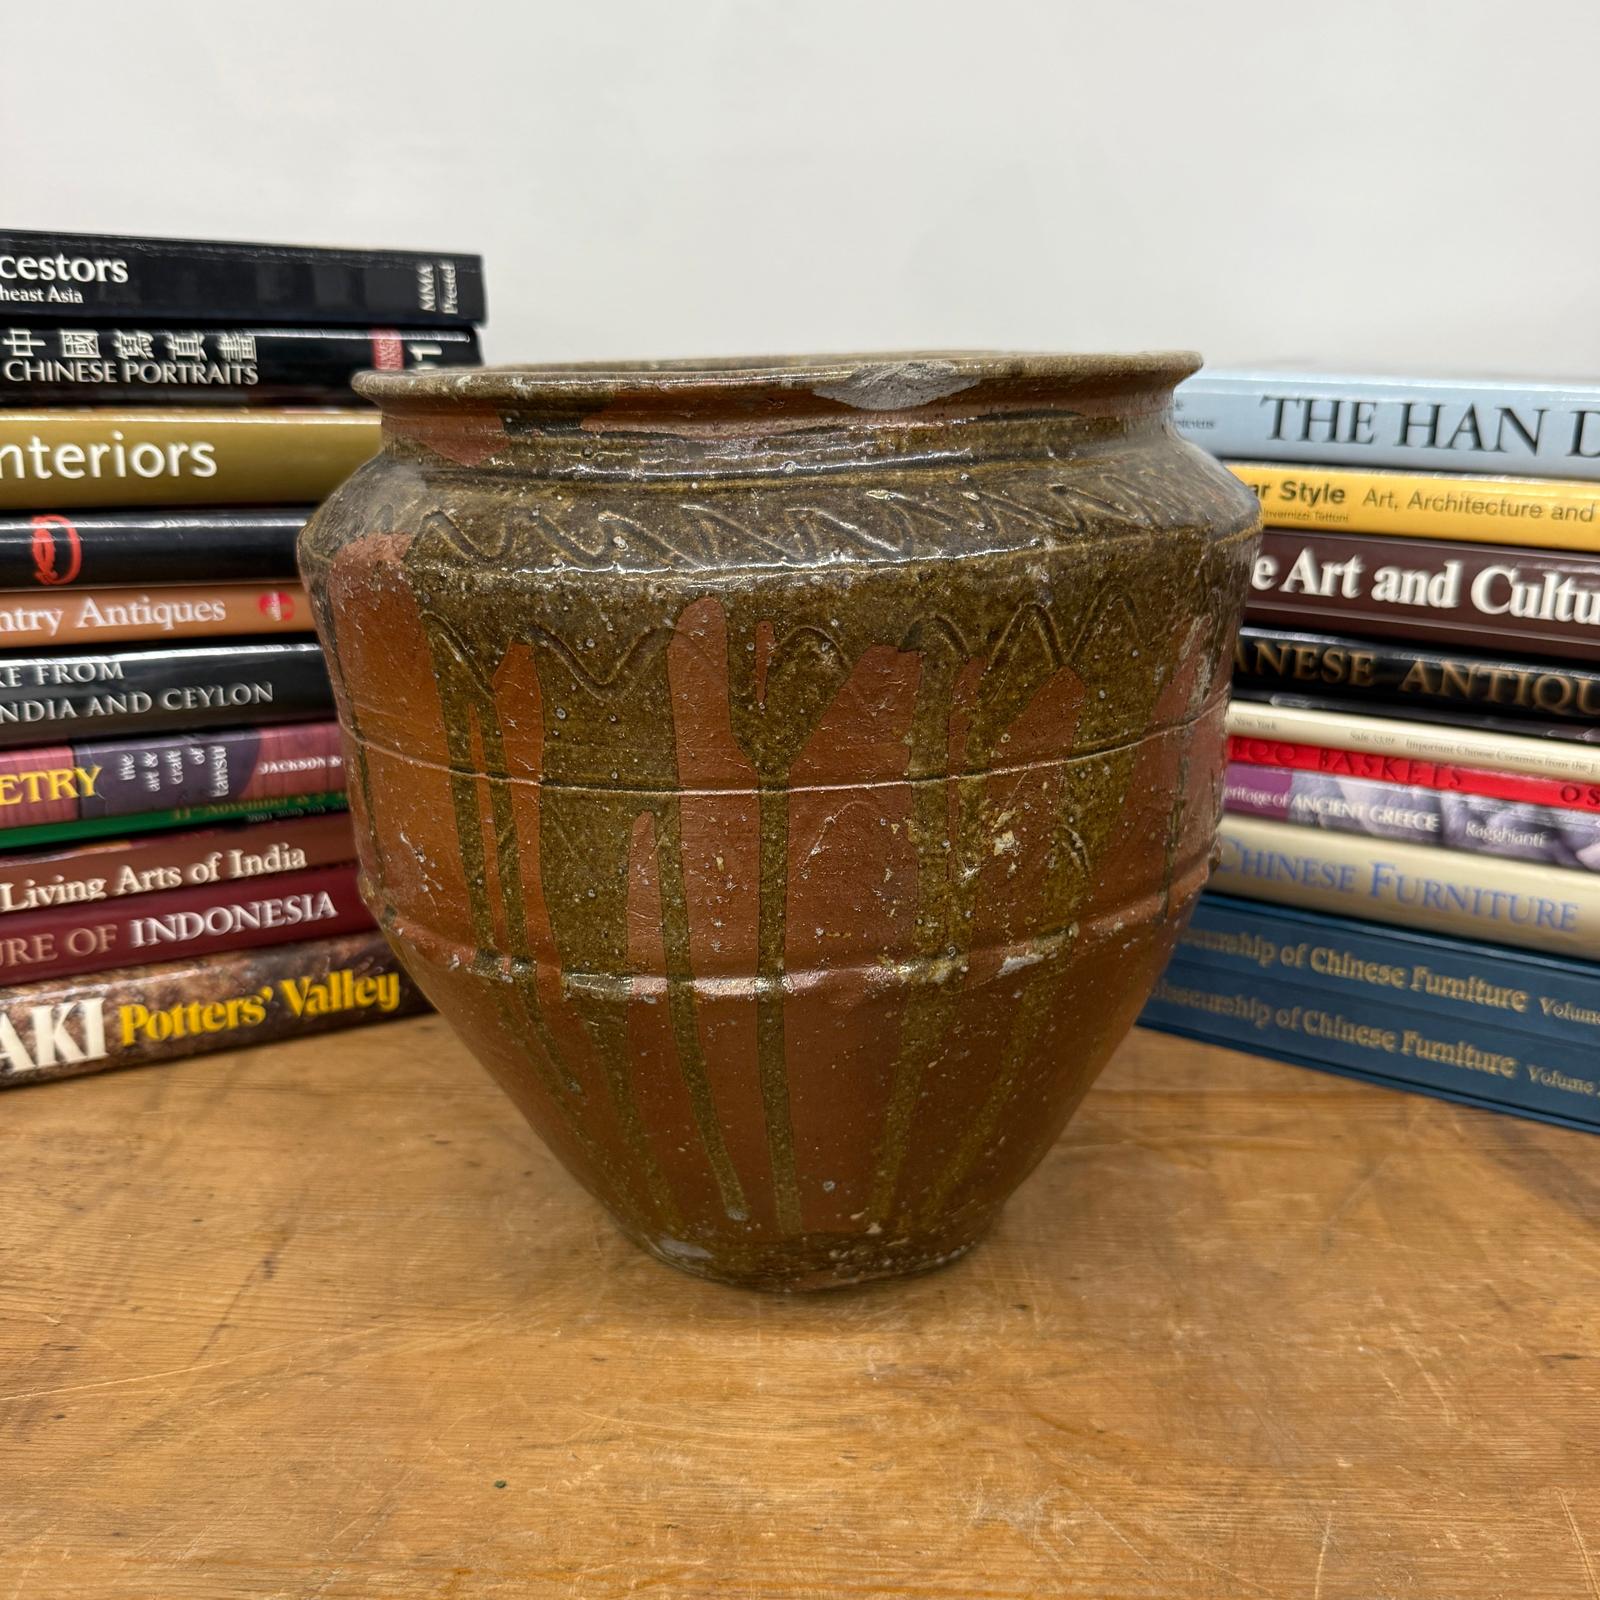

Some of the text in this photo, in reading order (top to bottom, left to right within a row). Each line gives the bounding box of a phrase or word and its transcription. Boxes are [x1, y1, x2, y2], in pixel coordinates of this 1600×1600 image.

[0, 253, 129, 283] cestors
[416, 261, 436, 312] MMA
[48, 285, 84, 304] Asia
[3, 360, 259, 385] CHINESE PORTRAITS
[1262, 394, 1378, 445] THE
[1394, 402, 1550, 456] HAN
[0, 431, 217, 480] nteriors
[1279, 480, 1346, 507] Style
[1362, 488, 1400, 512] Art,
[1407, 491, 1544, 520] Architecture
[1550, 502, 1596, 523] and
[1278, 546, 1364, 599] Art
[1371, 559, 1463, 609] and
[76, 596, 227, 629] Antiques
[35, 661, 125, 685] FROM
[87, 691, 153, 717] AND
[161, 681, 275, 712] CEYLON
[257, 758, 326, 775] JACKSON
[1405, 739, 1454, 756] Important
[0, 764, 102, 805] ETRY
[1290, 794, 1364, 818] ANCIENT
[1369, 805, 1440, 833] GREECE
[0, 842, 307, 913] Living Arts of India
[1370, 862, 1580, 932] FURNITURE
[67, 923, 118, 956] OF
[130, 890, 338, 948] INDONESIA
[279, 969, 400, 1018] Valley
[1280, 943, 1309, 967] of
[1310, 946, 1407, 988] Chinese
[1411, 965, 1530, 1013] Furniture
[1275, 1004, 1302, 1029] of
[1303, 1009, 1397, 1053] Chinese
[1402, 1030, 1518, 1079] Furniture
[1526, 1065, 1596, 1096] Volume
